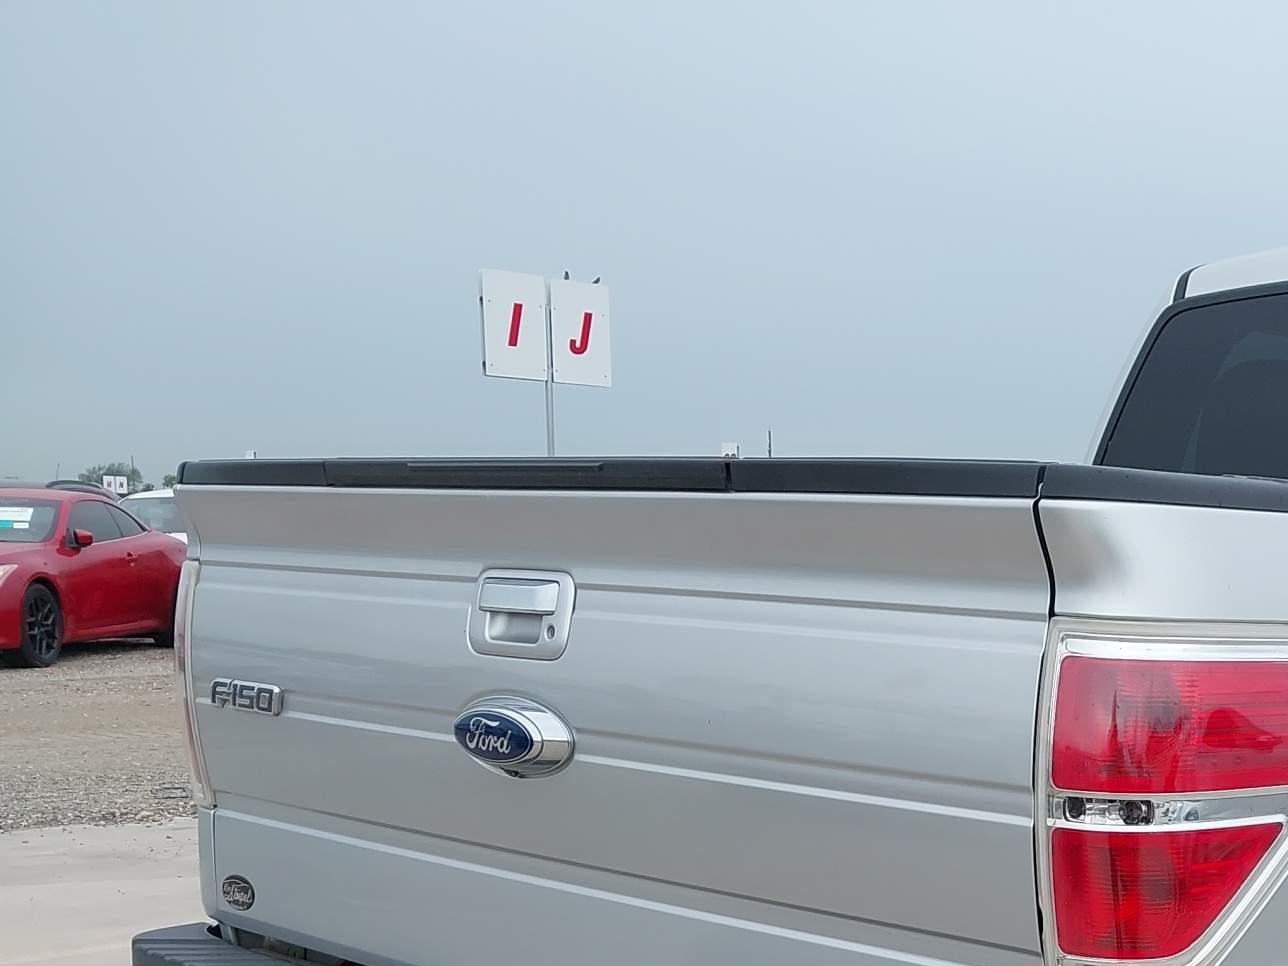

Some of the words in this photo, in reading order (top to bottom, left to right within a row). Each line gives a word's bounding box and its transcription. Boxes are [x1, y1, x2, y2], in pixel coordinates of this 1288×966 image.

[507, 302, 524, 348] I
[568, 311, 594, 356] J
[465, 716, 512, 755] Ford
